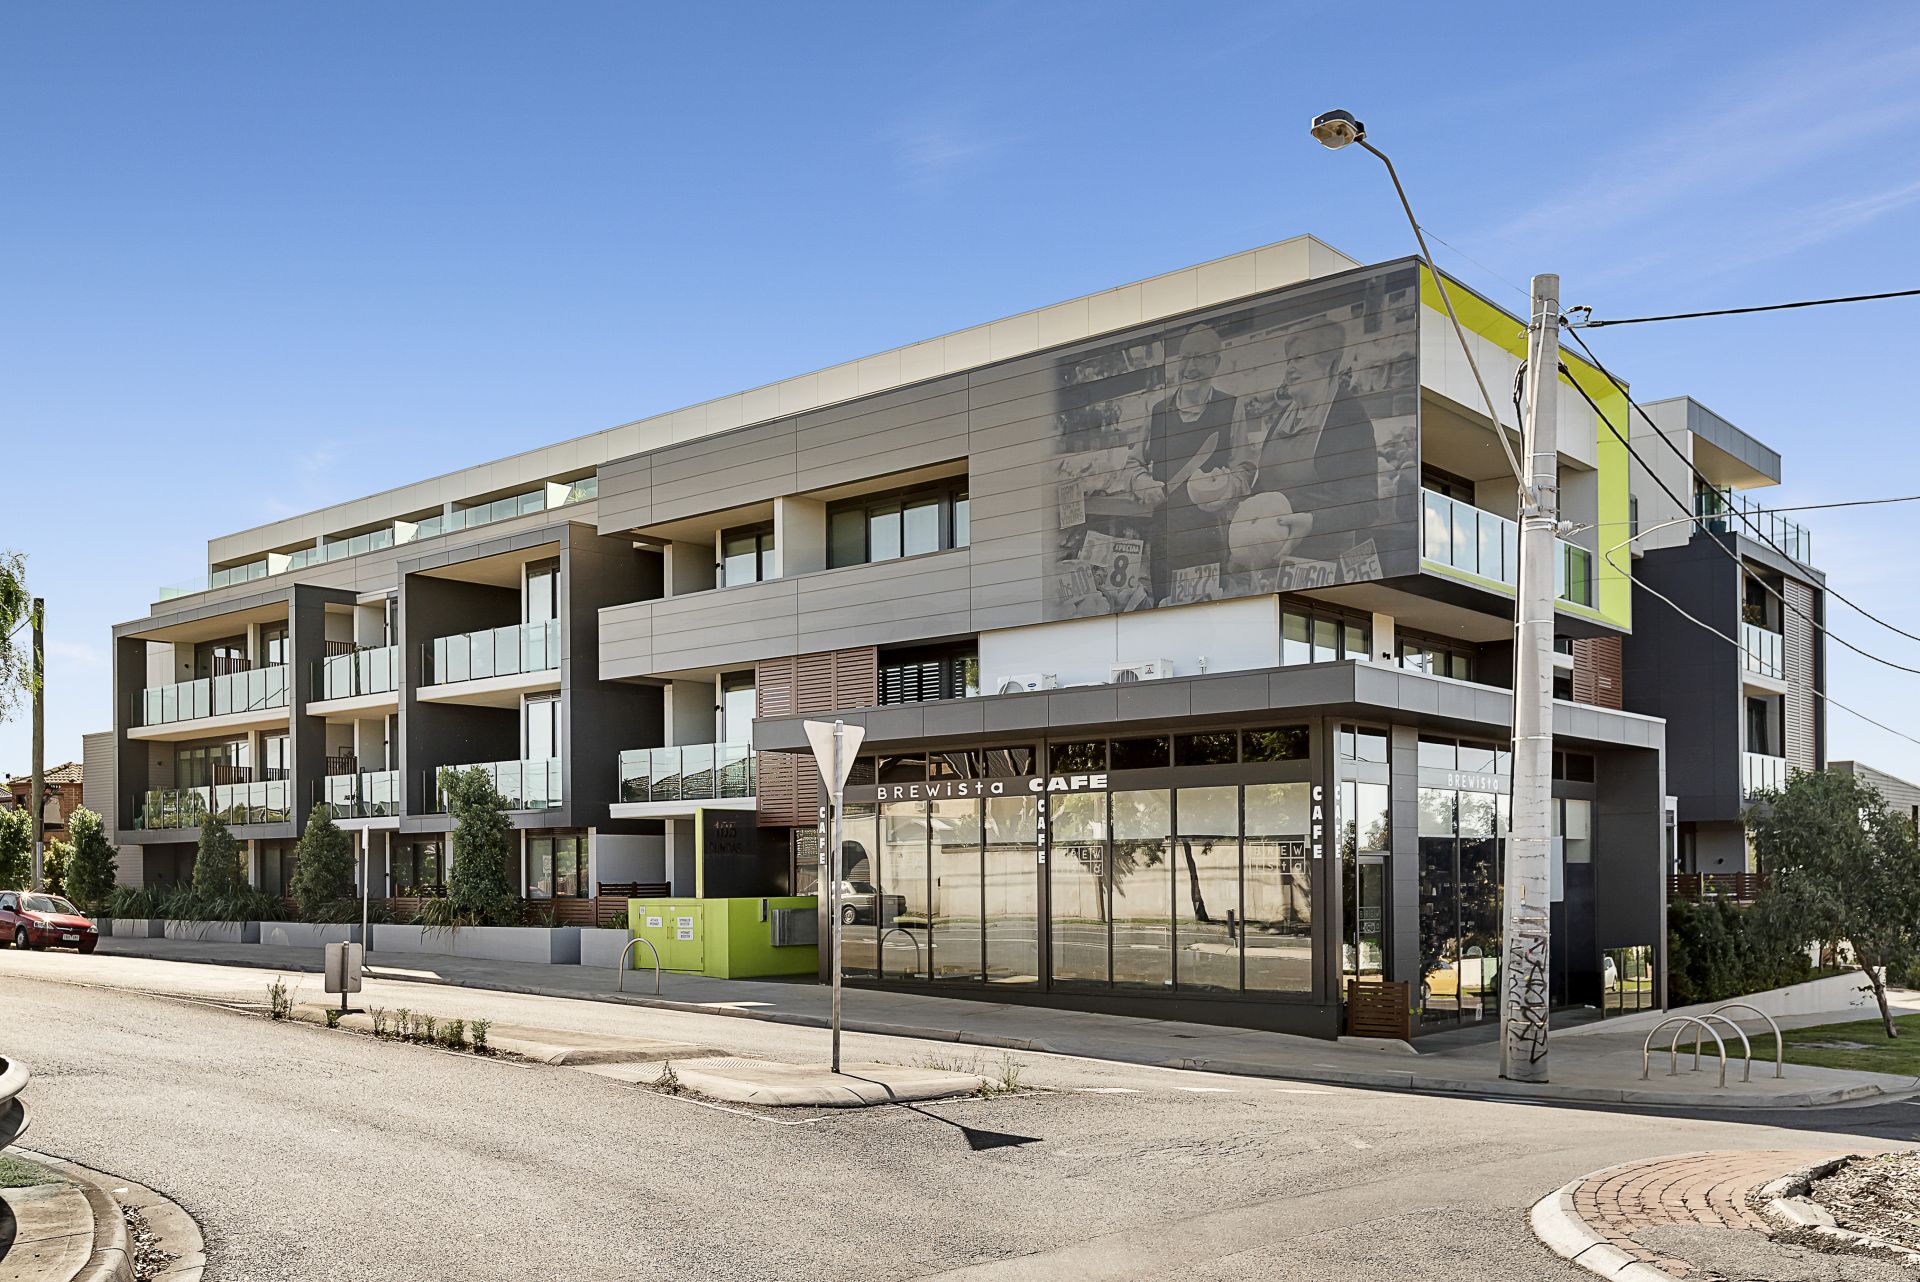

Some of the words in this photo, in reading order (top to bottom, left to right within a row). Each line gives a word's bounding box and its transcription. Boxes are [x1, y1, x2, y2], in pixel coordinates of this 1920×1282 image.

[877, 781, 1004, 800] BREWista
[1028, 773, 1108, 792] CAFE
[819, 806, 827, 865] CAFE
[1038, 799, 1046, 864] CAFE
[1312, 785, 1323, 859] CAFE
